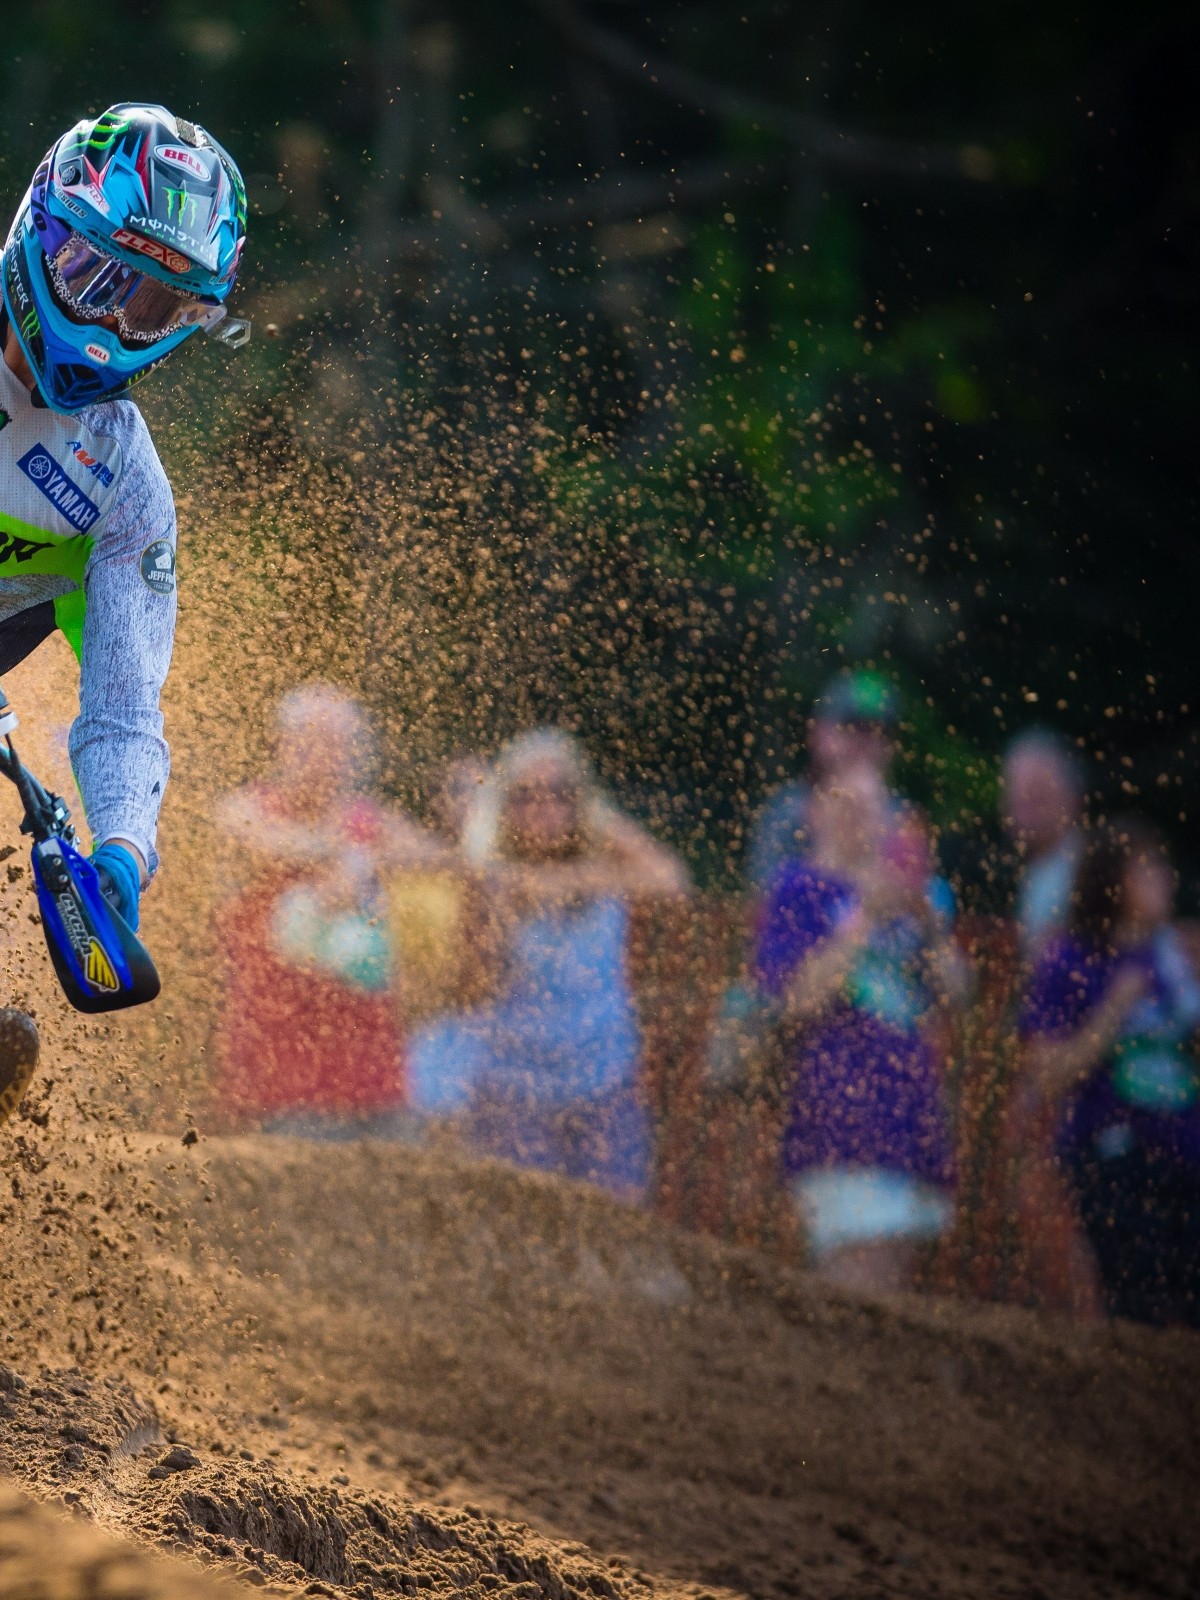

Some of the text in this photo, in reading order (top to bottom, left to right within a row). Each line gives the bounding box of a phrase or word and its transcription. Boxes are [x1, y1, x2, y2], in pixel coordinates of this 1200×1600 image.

[163, 148, 203, 175] BELL
[112, 230, 175, 263] FLEX
[88, 346, 107, 361] BELL
[58, 893, 93, 956] CYCRA
